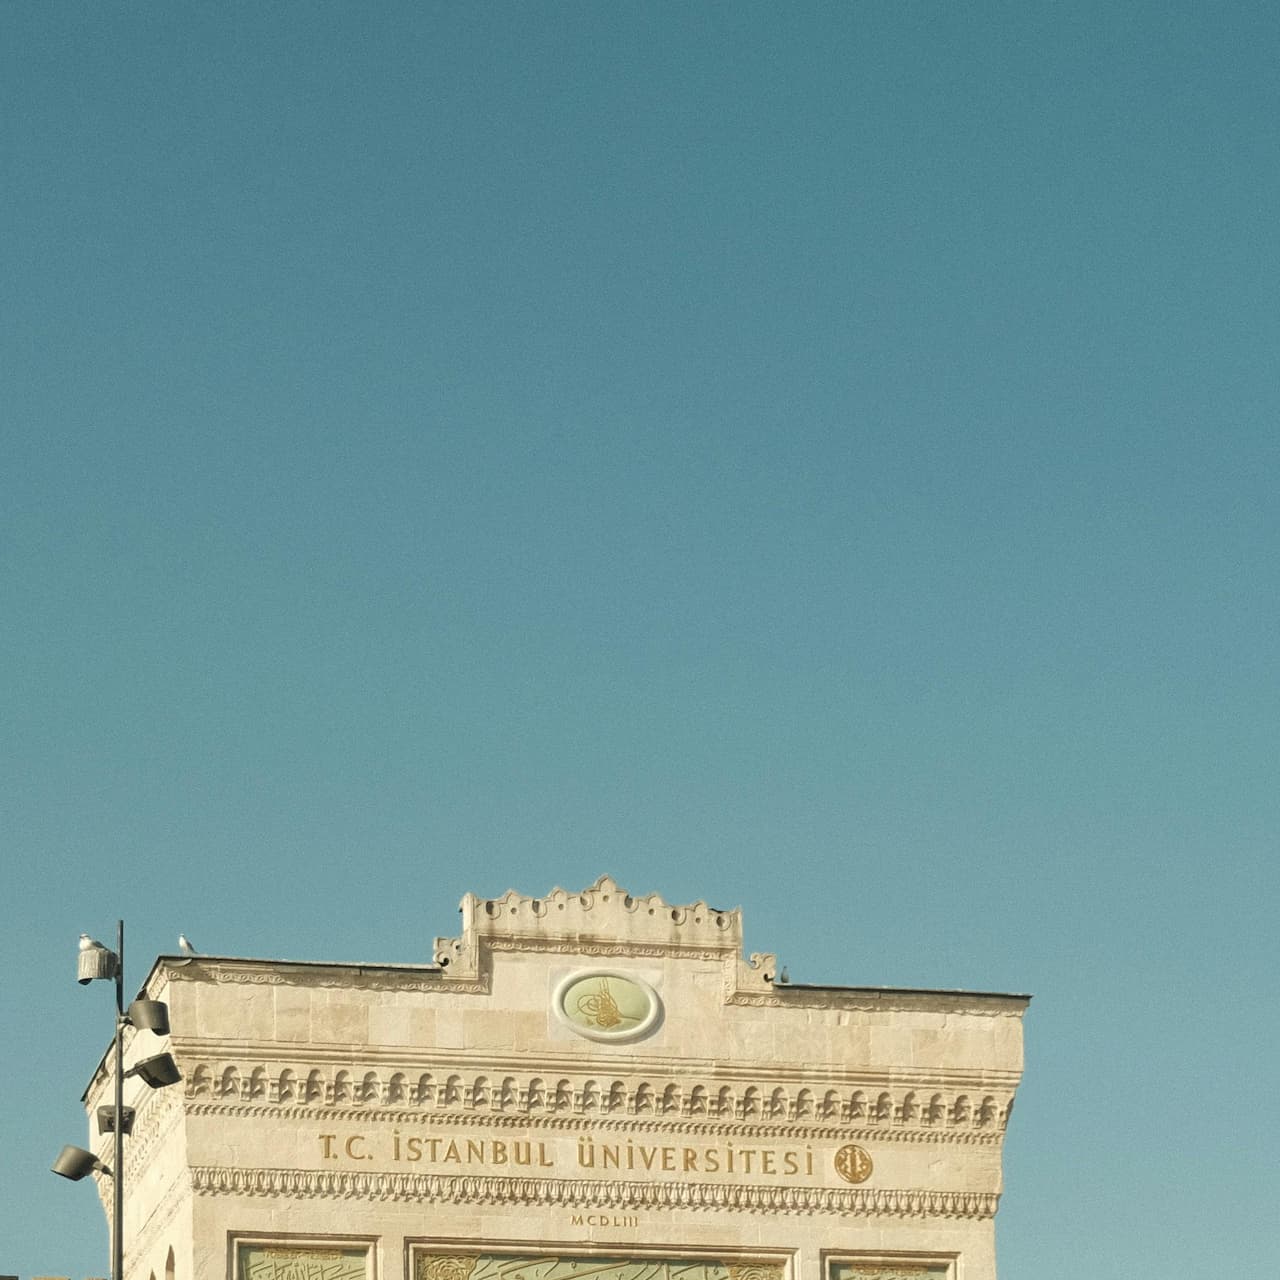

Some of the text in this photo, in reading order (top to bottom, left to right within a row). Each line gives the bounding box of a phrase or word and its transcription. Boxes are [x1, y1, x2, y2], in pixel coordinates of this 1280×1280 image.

[393, 1129, 554, 1167] İSTANBUL
[577, 1136, 814, 1176] ÜNİVERSİTESİ
[570, 1215, 639, 1227] MCDLIII
